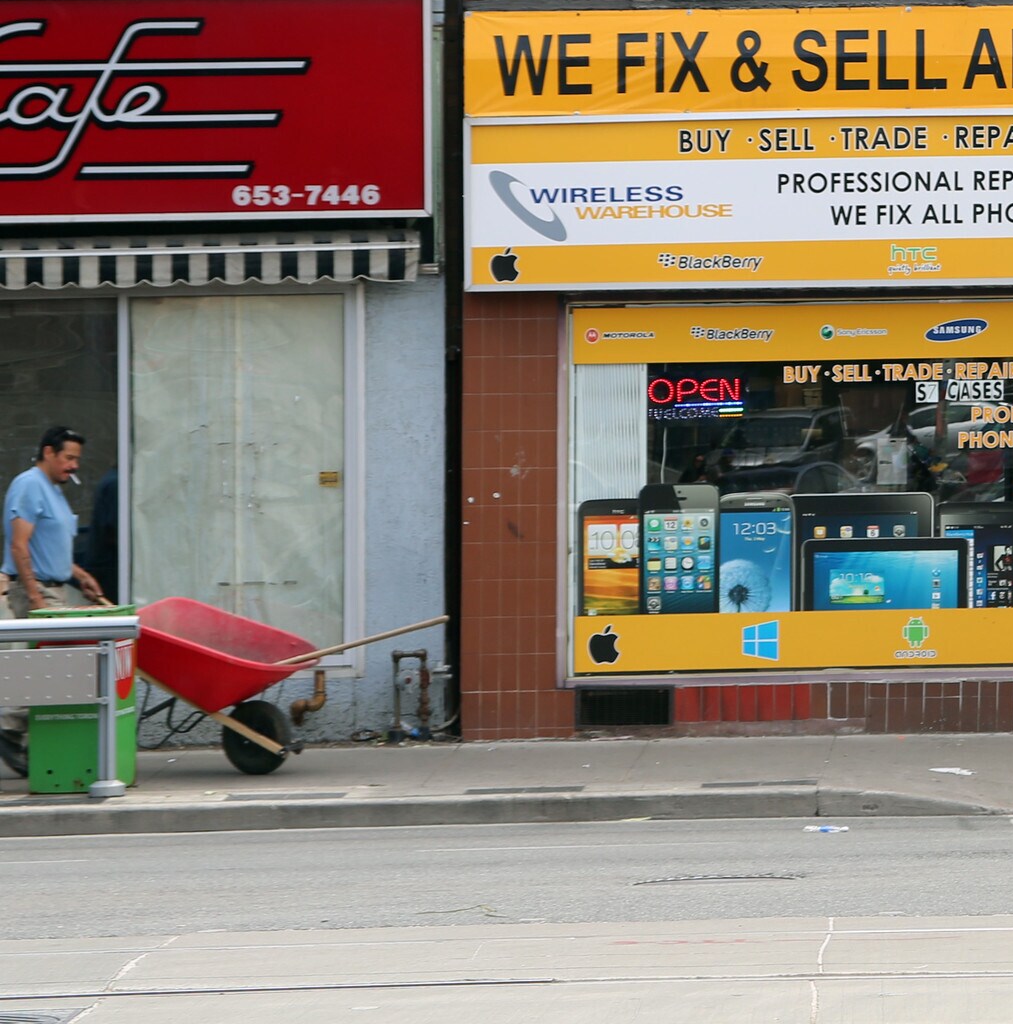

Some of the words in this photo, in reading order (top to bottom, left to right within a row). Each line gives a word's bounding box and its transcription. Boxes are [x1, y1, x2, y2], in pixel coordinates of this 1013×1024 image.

[494, 33, 593, 96] WE
[617, 32, 710, 94] FIX
[730, 29, 771, 92] &
[792, 29, 947, 92] SELL
[679, 129, 731, 153] BUY
[777, 171, 963, 194] PROFESSIONAL
[231, 184, 381, 206] 653-7446
[530, 186, 683, 203] WIRELESS
[575, 204, 733, 220] WAREHOUSE
[831, 205, 867, 226] WE
[877, 204, 912, 225] FIX
[922, 203, 963, 225] ALL
[678, 254, 763, 271] BlackBerry
[603, 331, 655, 339] MOTOROLA
[706, 328, 773, 342] BlackBerry
[933, 324, 982, 335] SAMSUNG
[783, 365, 821, 384] BUY
[882, 362, 943, 382] TRADE
[647, 377, 741, 404] OPEN
[946, 380, 1003, 400] CASES
[733, 522, 777, 535] 12:03
